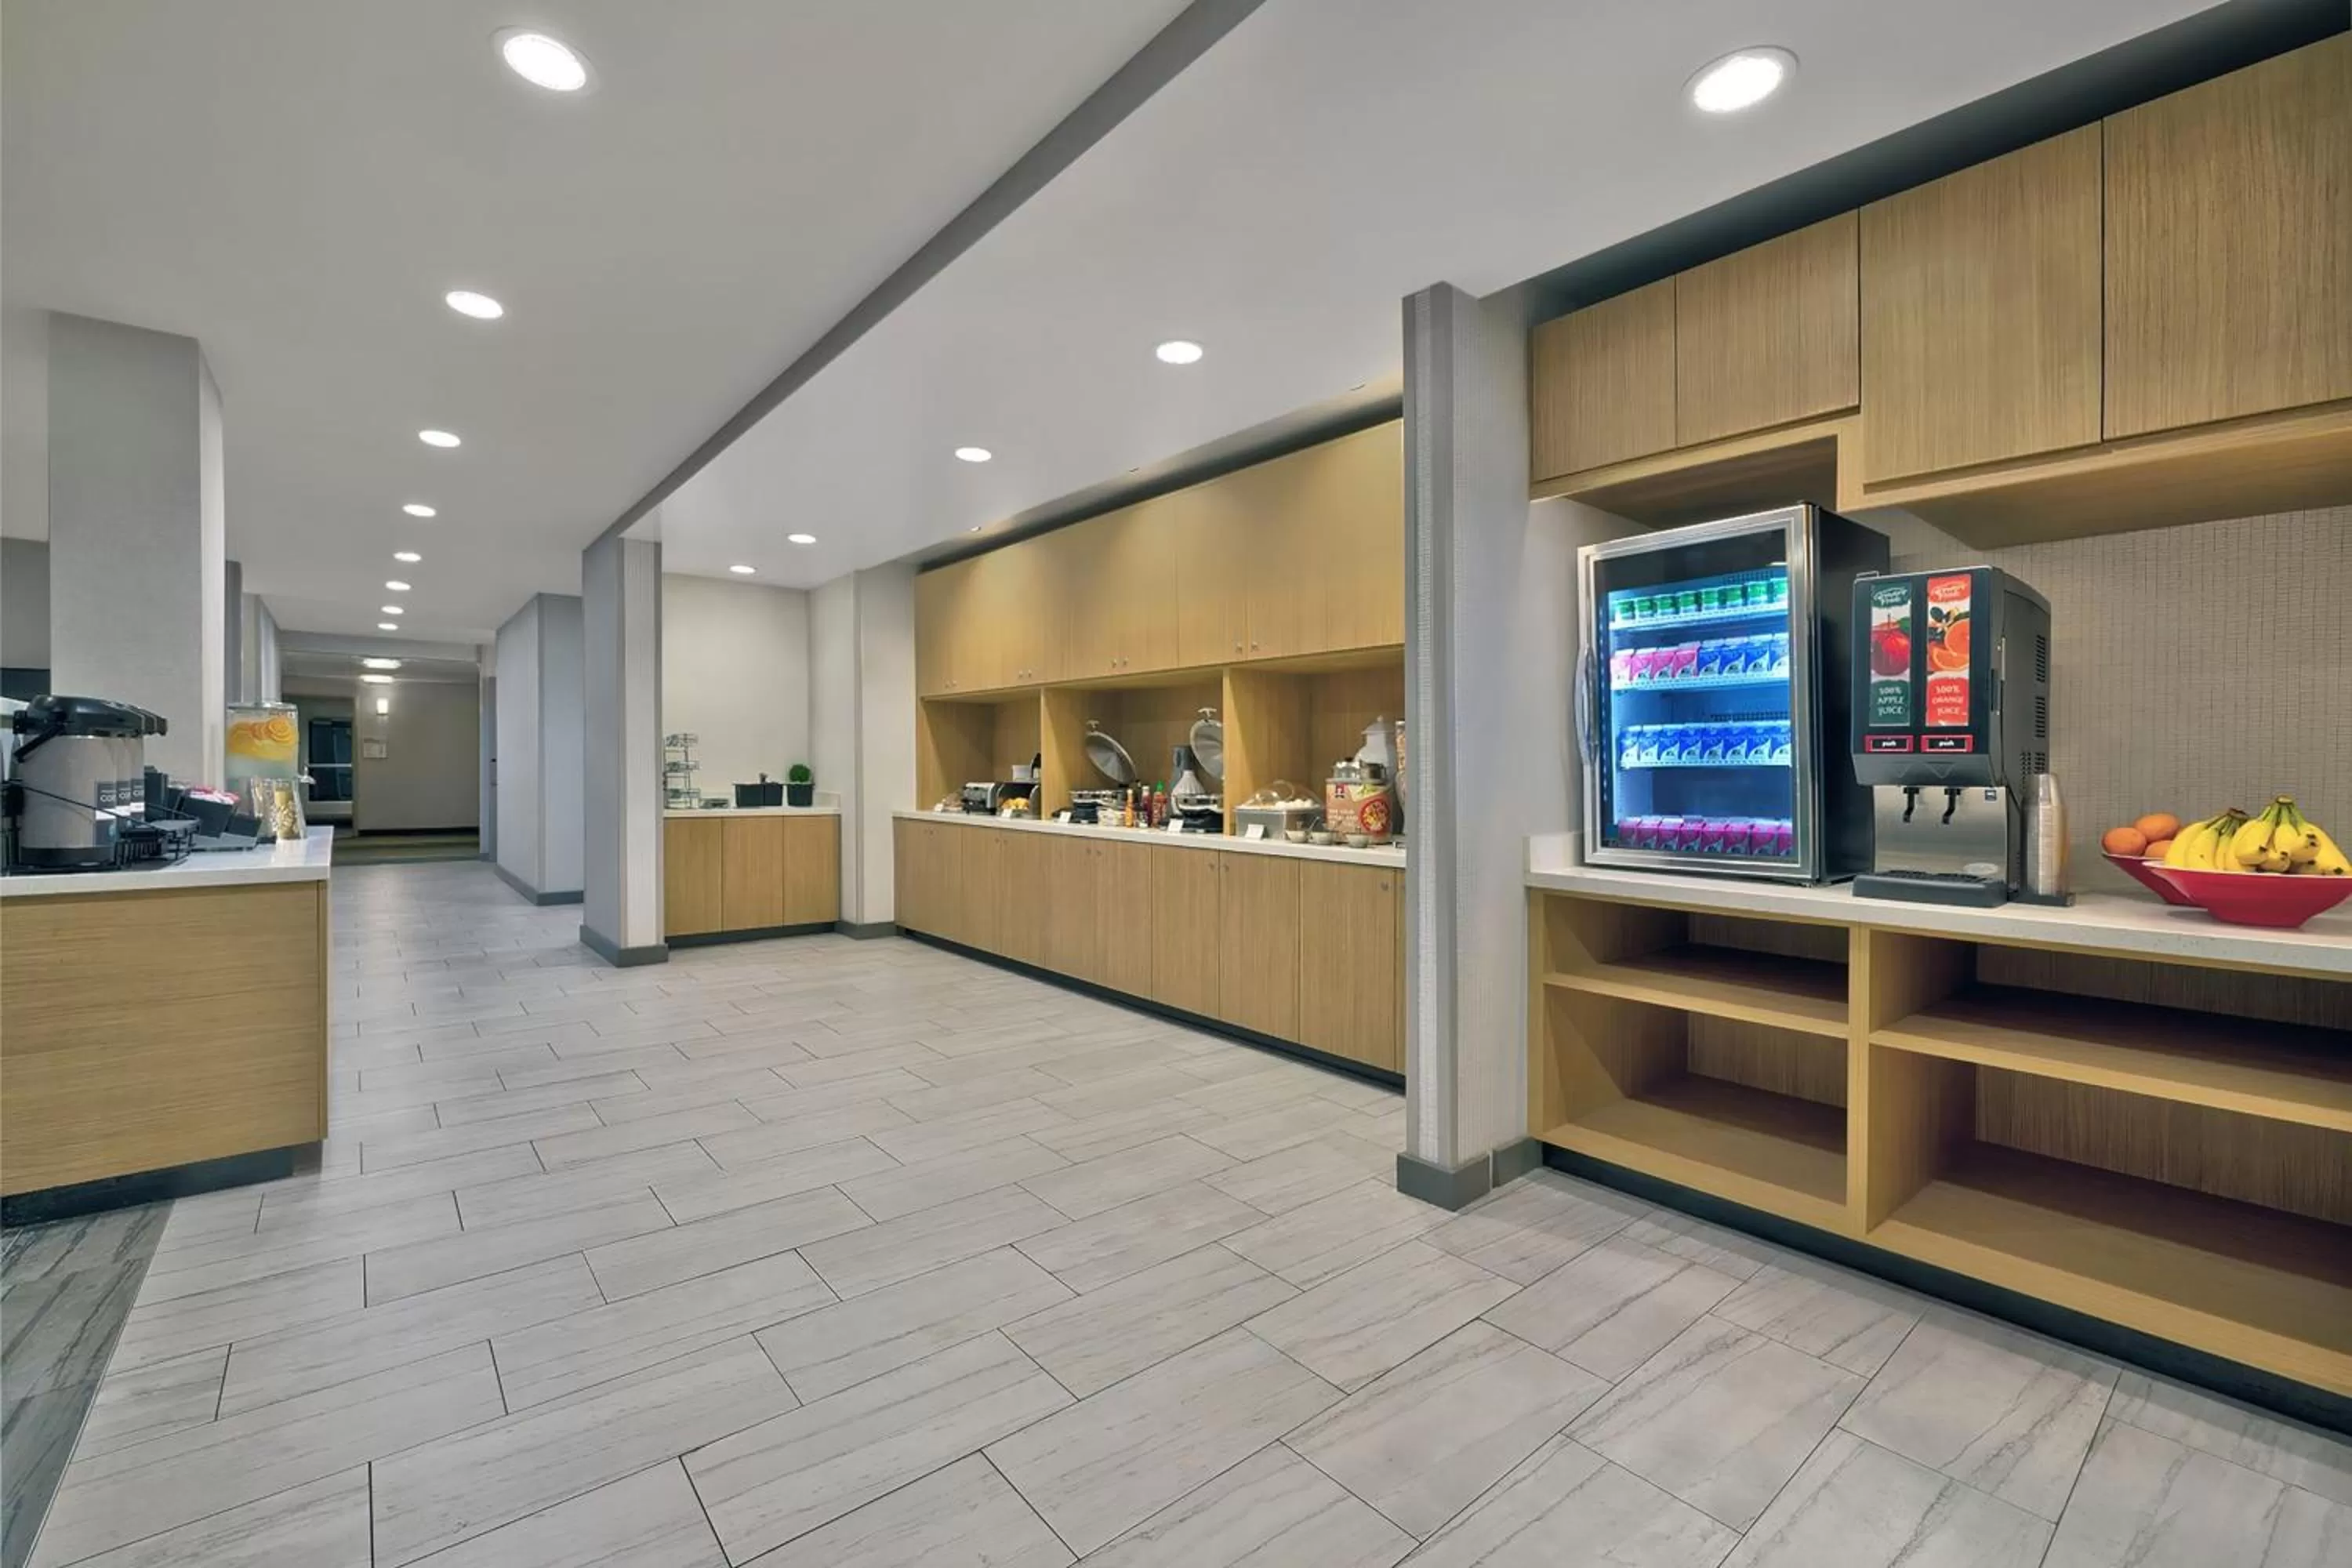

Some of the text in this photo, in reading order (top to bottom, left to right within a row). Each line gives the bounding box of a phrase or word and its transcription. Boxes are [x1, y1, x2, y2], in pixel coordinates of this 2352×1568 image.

[1879, 686, 1901, 695] 100%
[1936, 685, 1960, 694] 100%
[1877, 695, 1904, 704] APPLE
[1932, 695, 1964, 704] ORANGE
[1878, 706, 1904, 716] JUICE
[1937, 706, 1960, 715] JUICE
